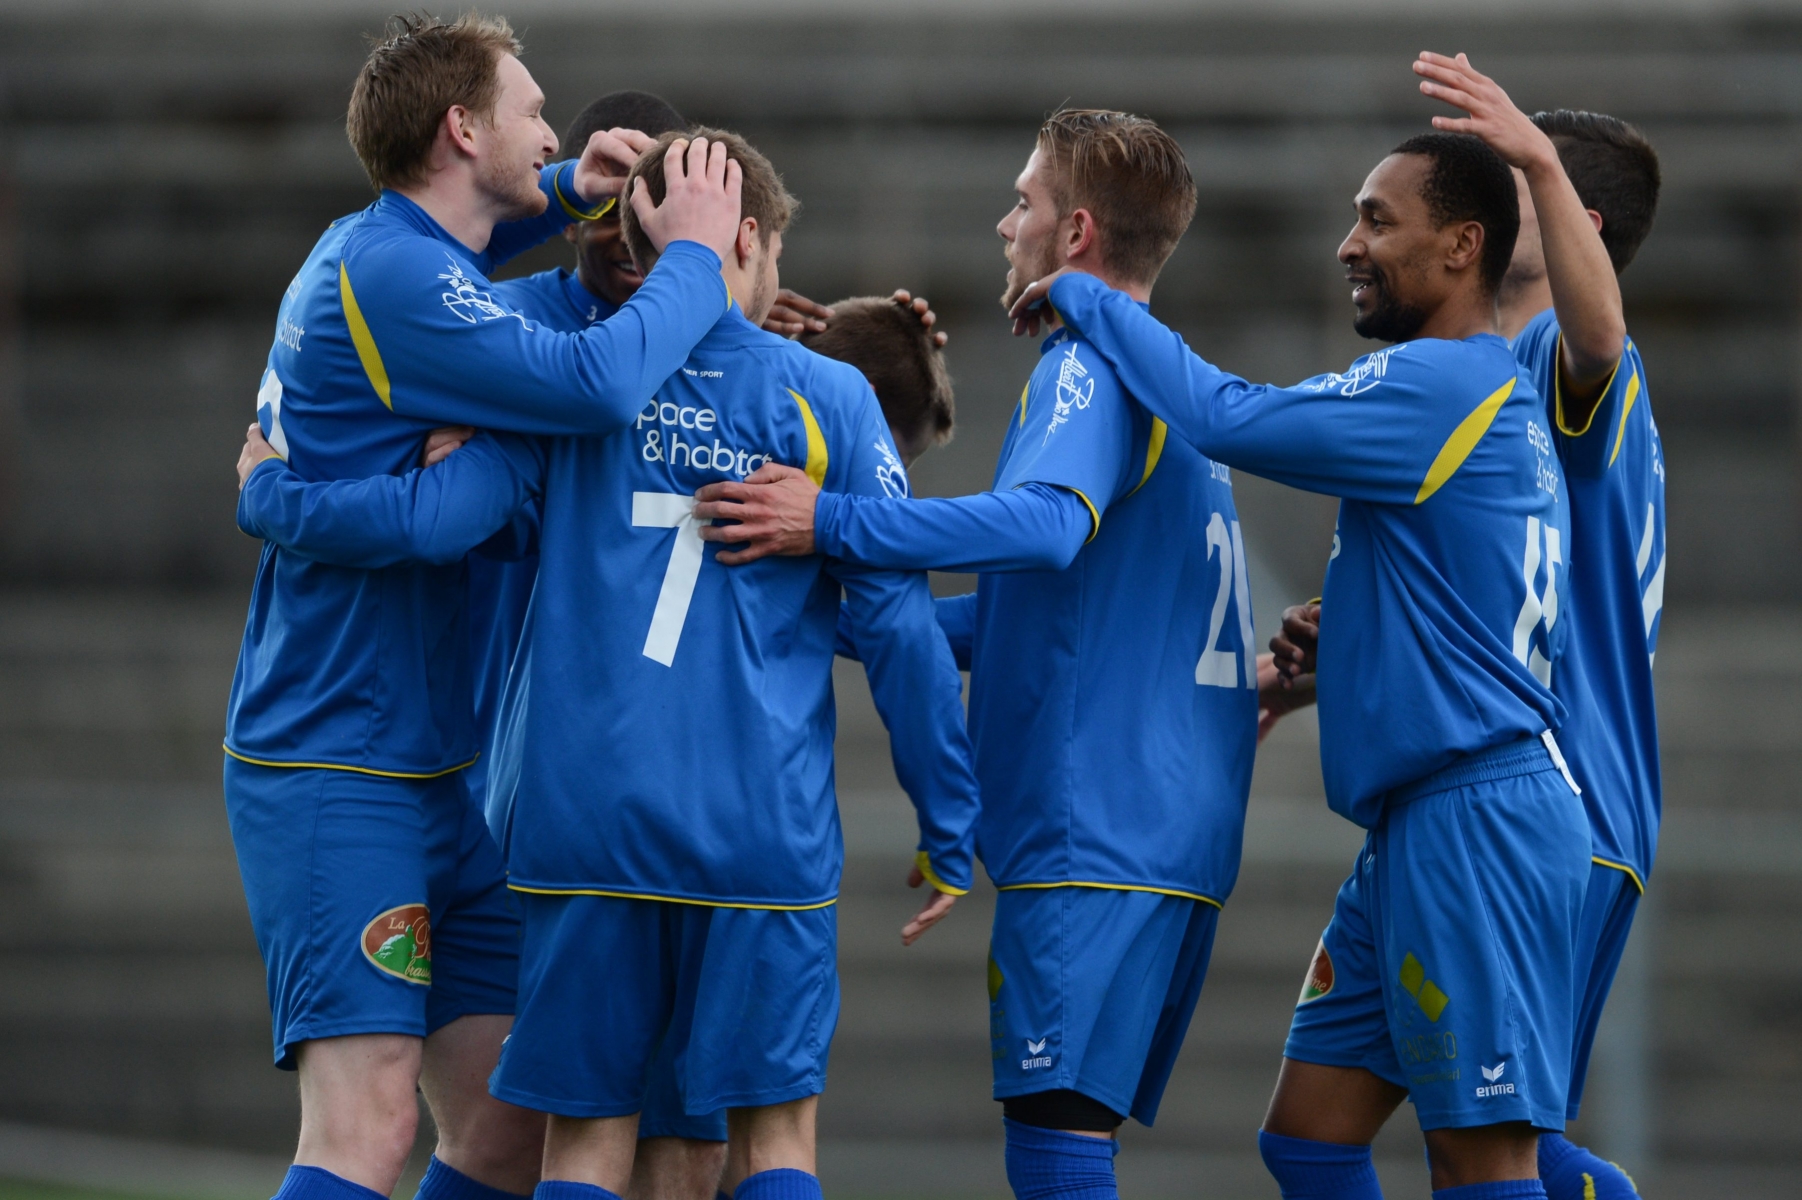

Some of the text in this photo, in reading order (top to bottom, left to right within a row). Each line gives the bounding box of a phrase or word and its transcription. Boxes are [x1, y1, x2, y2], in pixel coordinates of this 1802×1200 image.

[700, 371, 724, 379] SPORT
[636, 399, 717, 432] pace
[642, 429, 665, 462] &
[631, 491, 717, 668] 7
[387, 916, 406, 930] La
[1021, 1055, 1052, 1070] erima
[1475, 1082, 1515, 1098] erima
